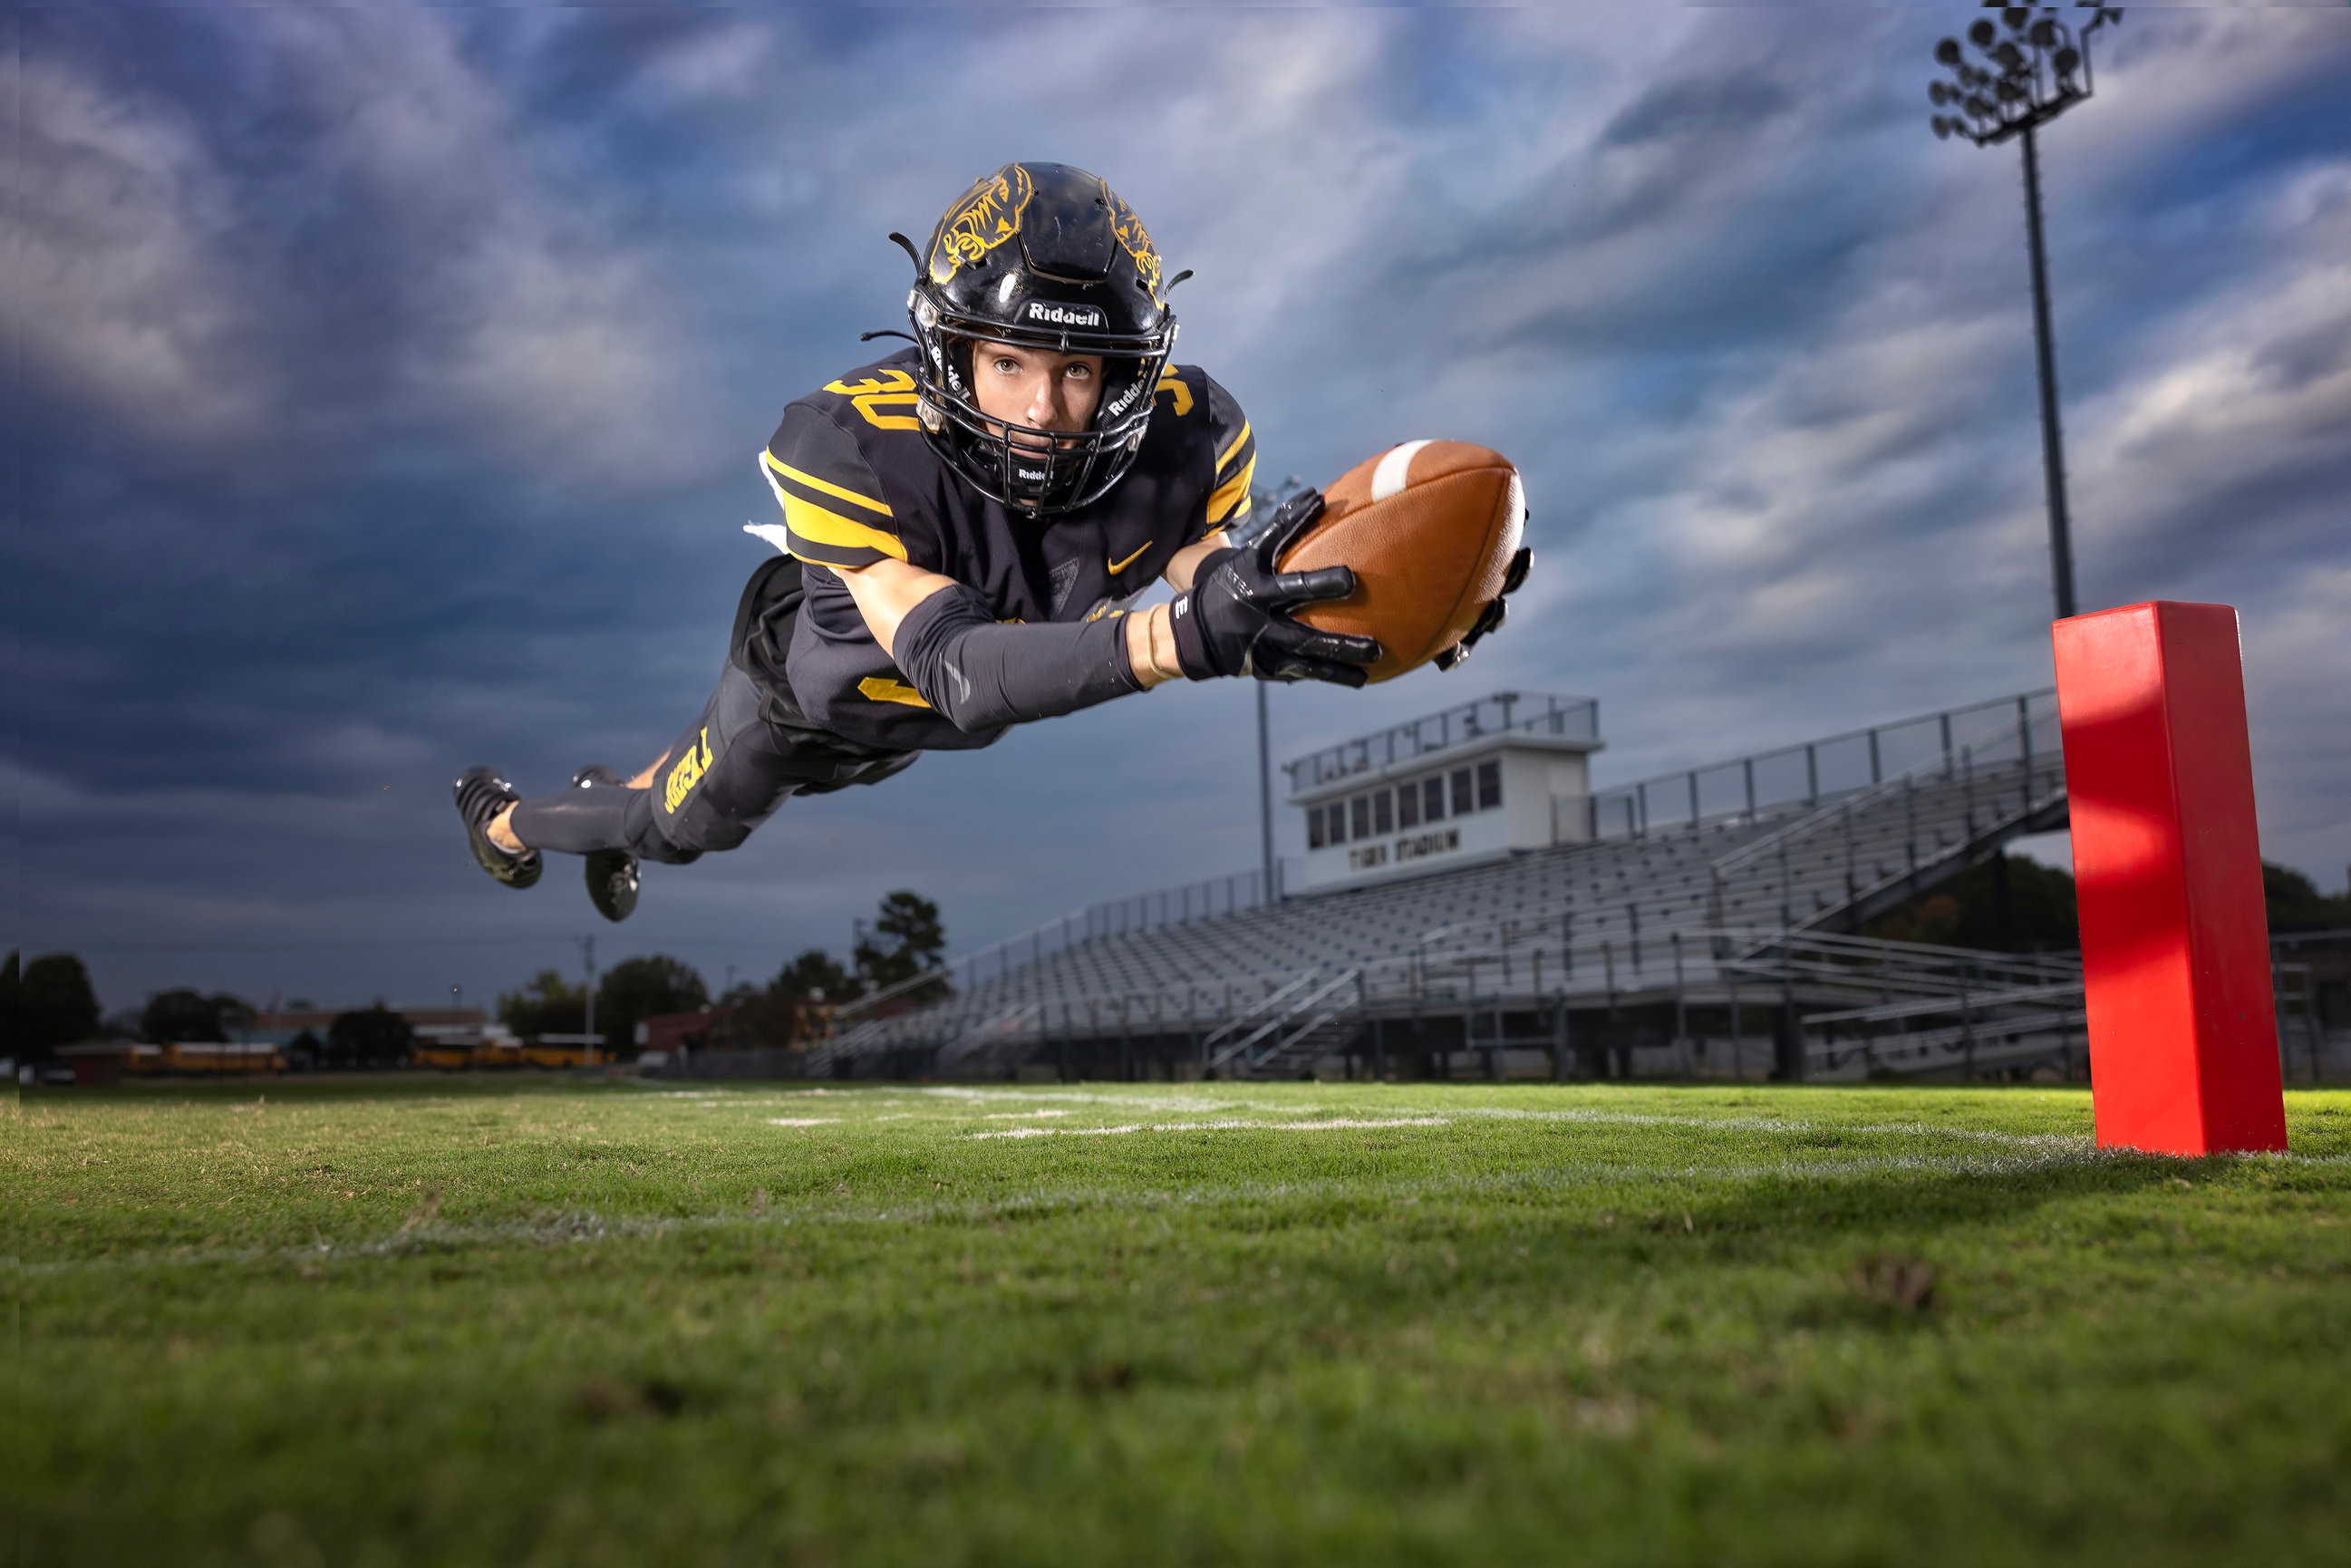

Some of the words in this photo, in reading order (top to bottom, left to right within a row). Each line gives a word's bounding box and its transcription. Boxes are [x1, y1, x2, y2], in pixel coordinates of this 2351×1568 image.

[1029, 302, 1099, 326] Riddell
[1108, 371, 1148, 417] Ridde
[1018, 468, 1054, 481] Riddel
